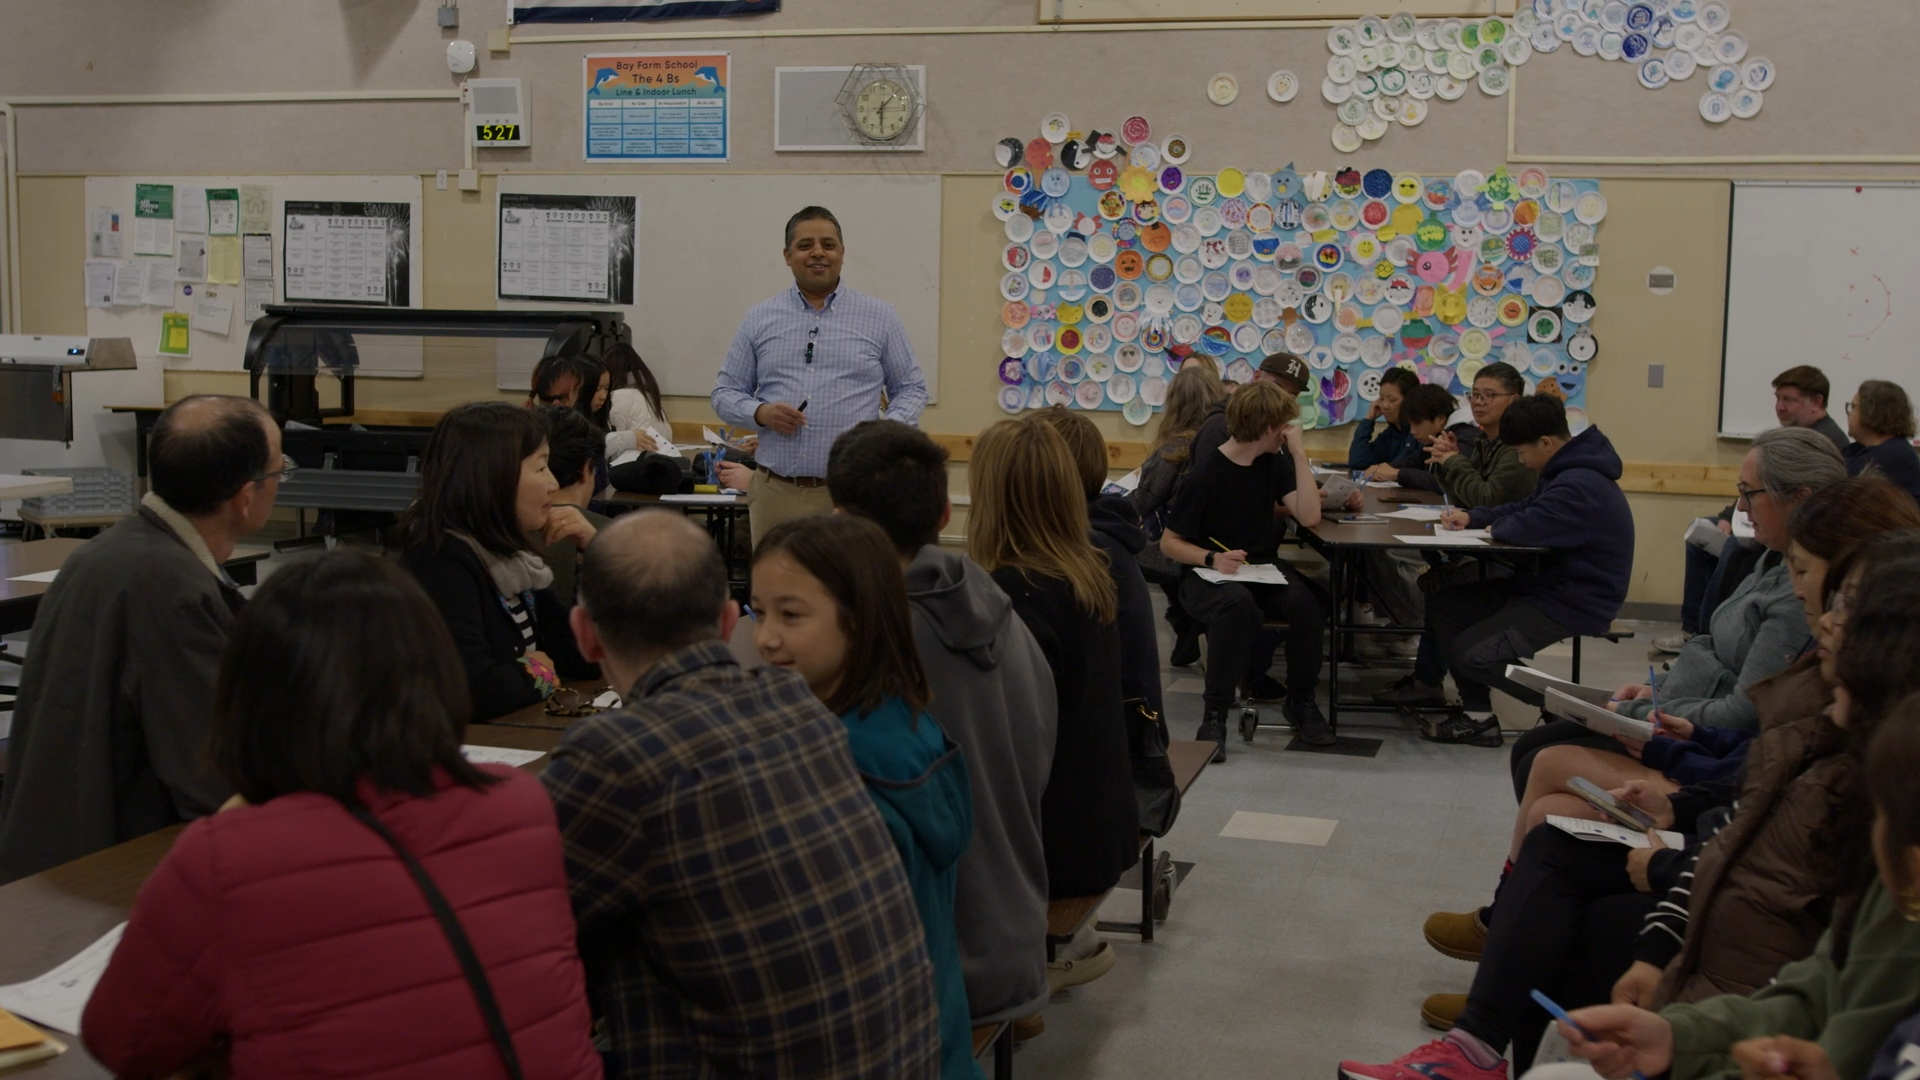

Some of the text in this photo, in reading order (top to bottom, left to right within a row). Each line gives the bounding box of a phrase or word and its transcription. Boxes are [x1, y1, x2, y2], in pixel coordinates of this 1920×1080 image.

[616, 60, 698, 71] Bay Farm School
[632, 73, 680, 84] The 4 Bs
[616, 88, 633, 96] Line
[1285, 359, 1302, 378] H
